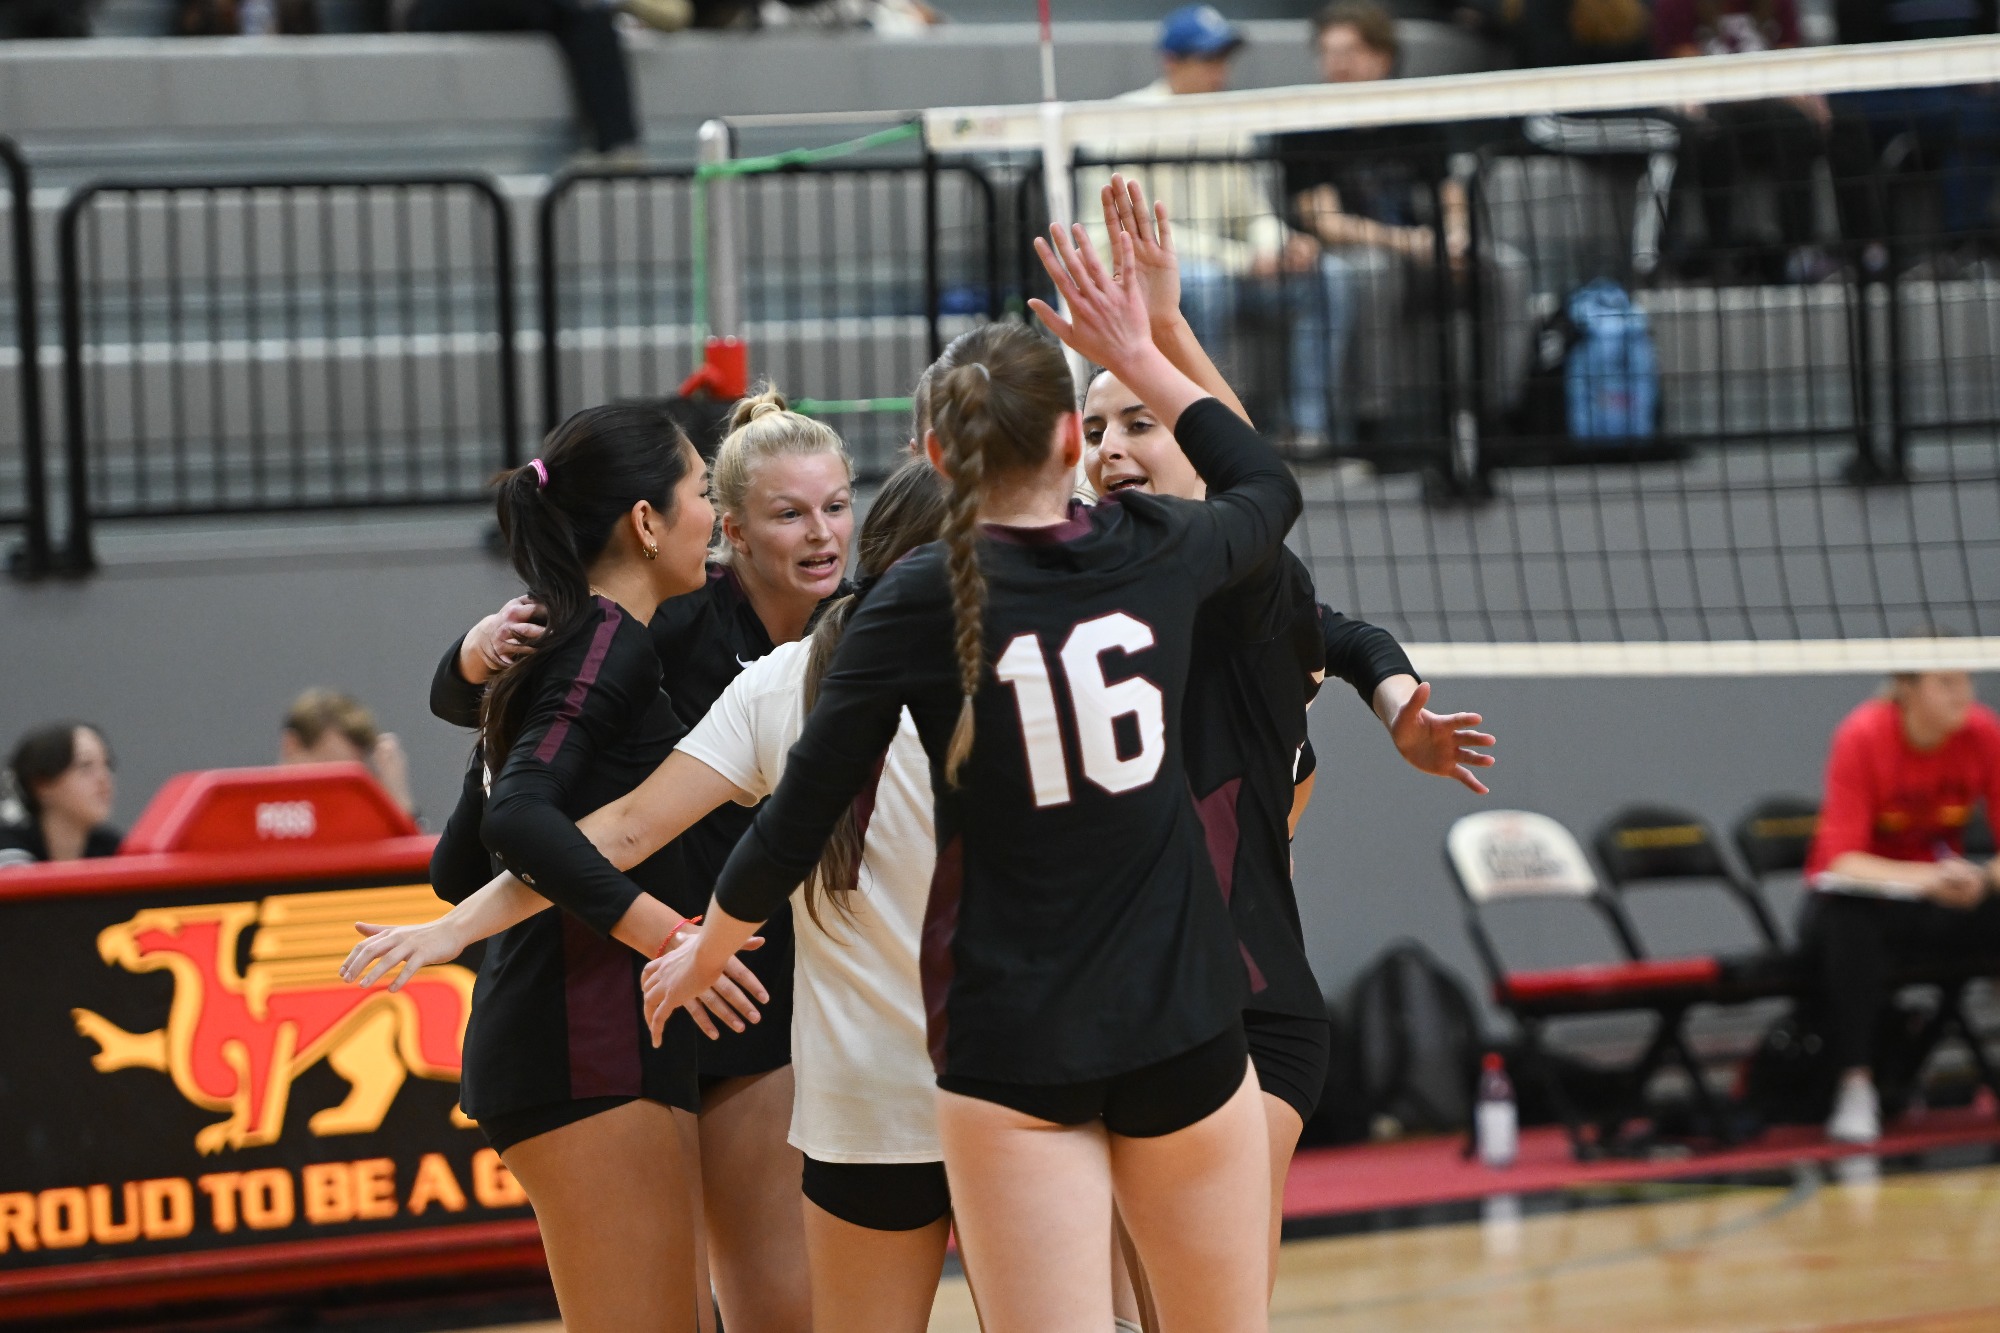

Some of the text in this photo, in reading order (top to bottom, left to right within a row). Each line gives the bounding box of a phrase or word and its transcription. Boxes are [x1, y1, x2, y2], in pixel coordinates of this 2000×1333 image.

[995, 610, 1166, 809] 16
[198, 1167, 296, 1234] TO
[301, 1156, 399, 1226] BE
[406, 1151, 468, 1217] A
